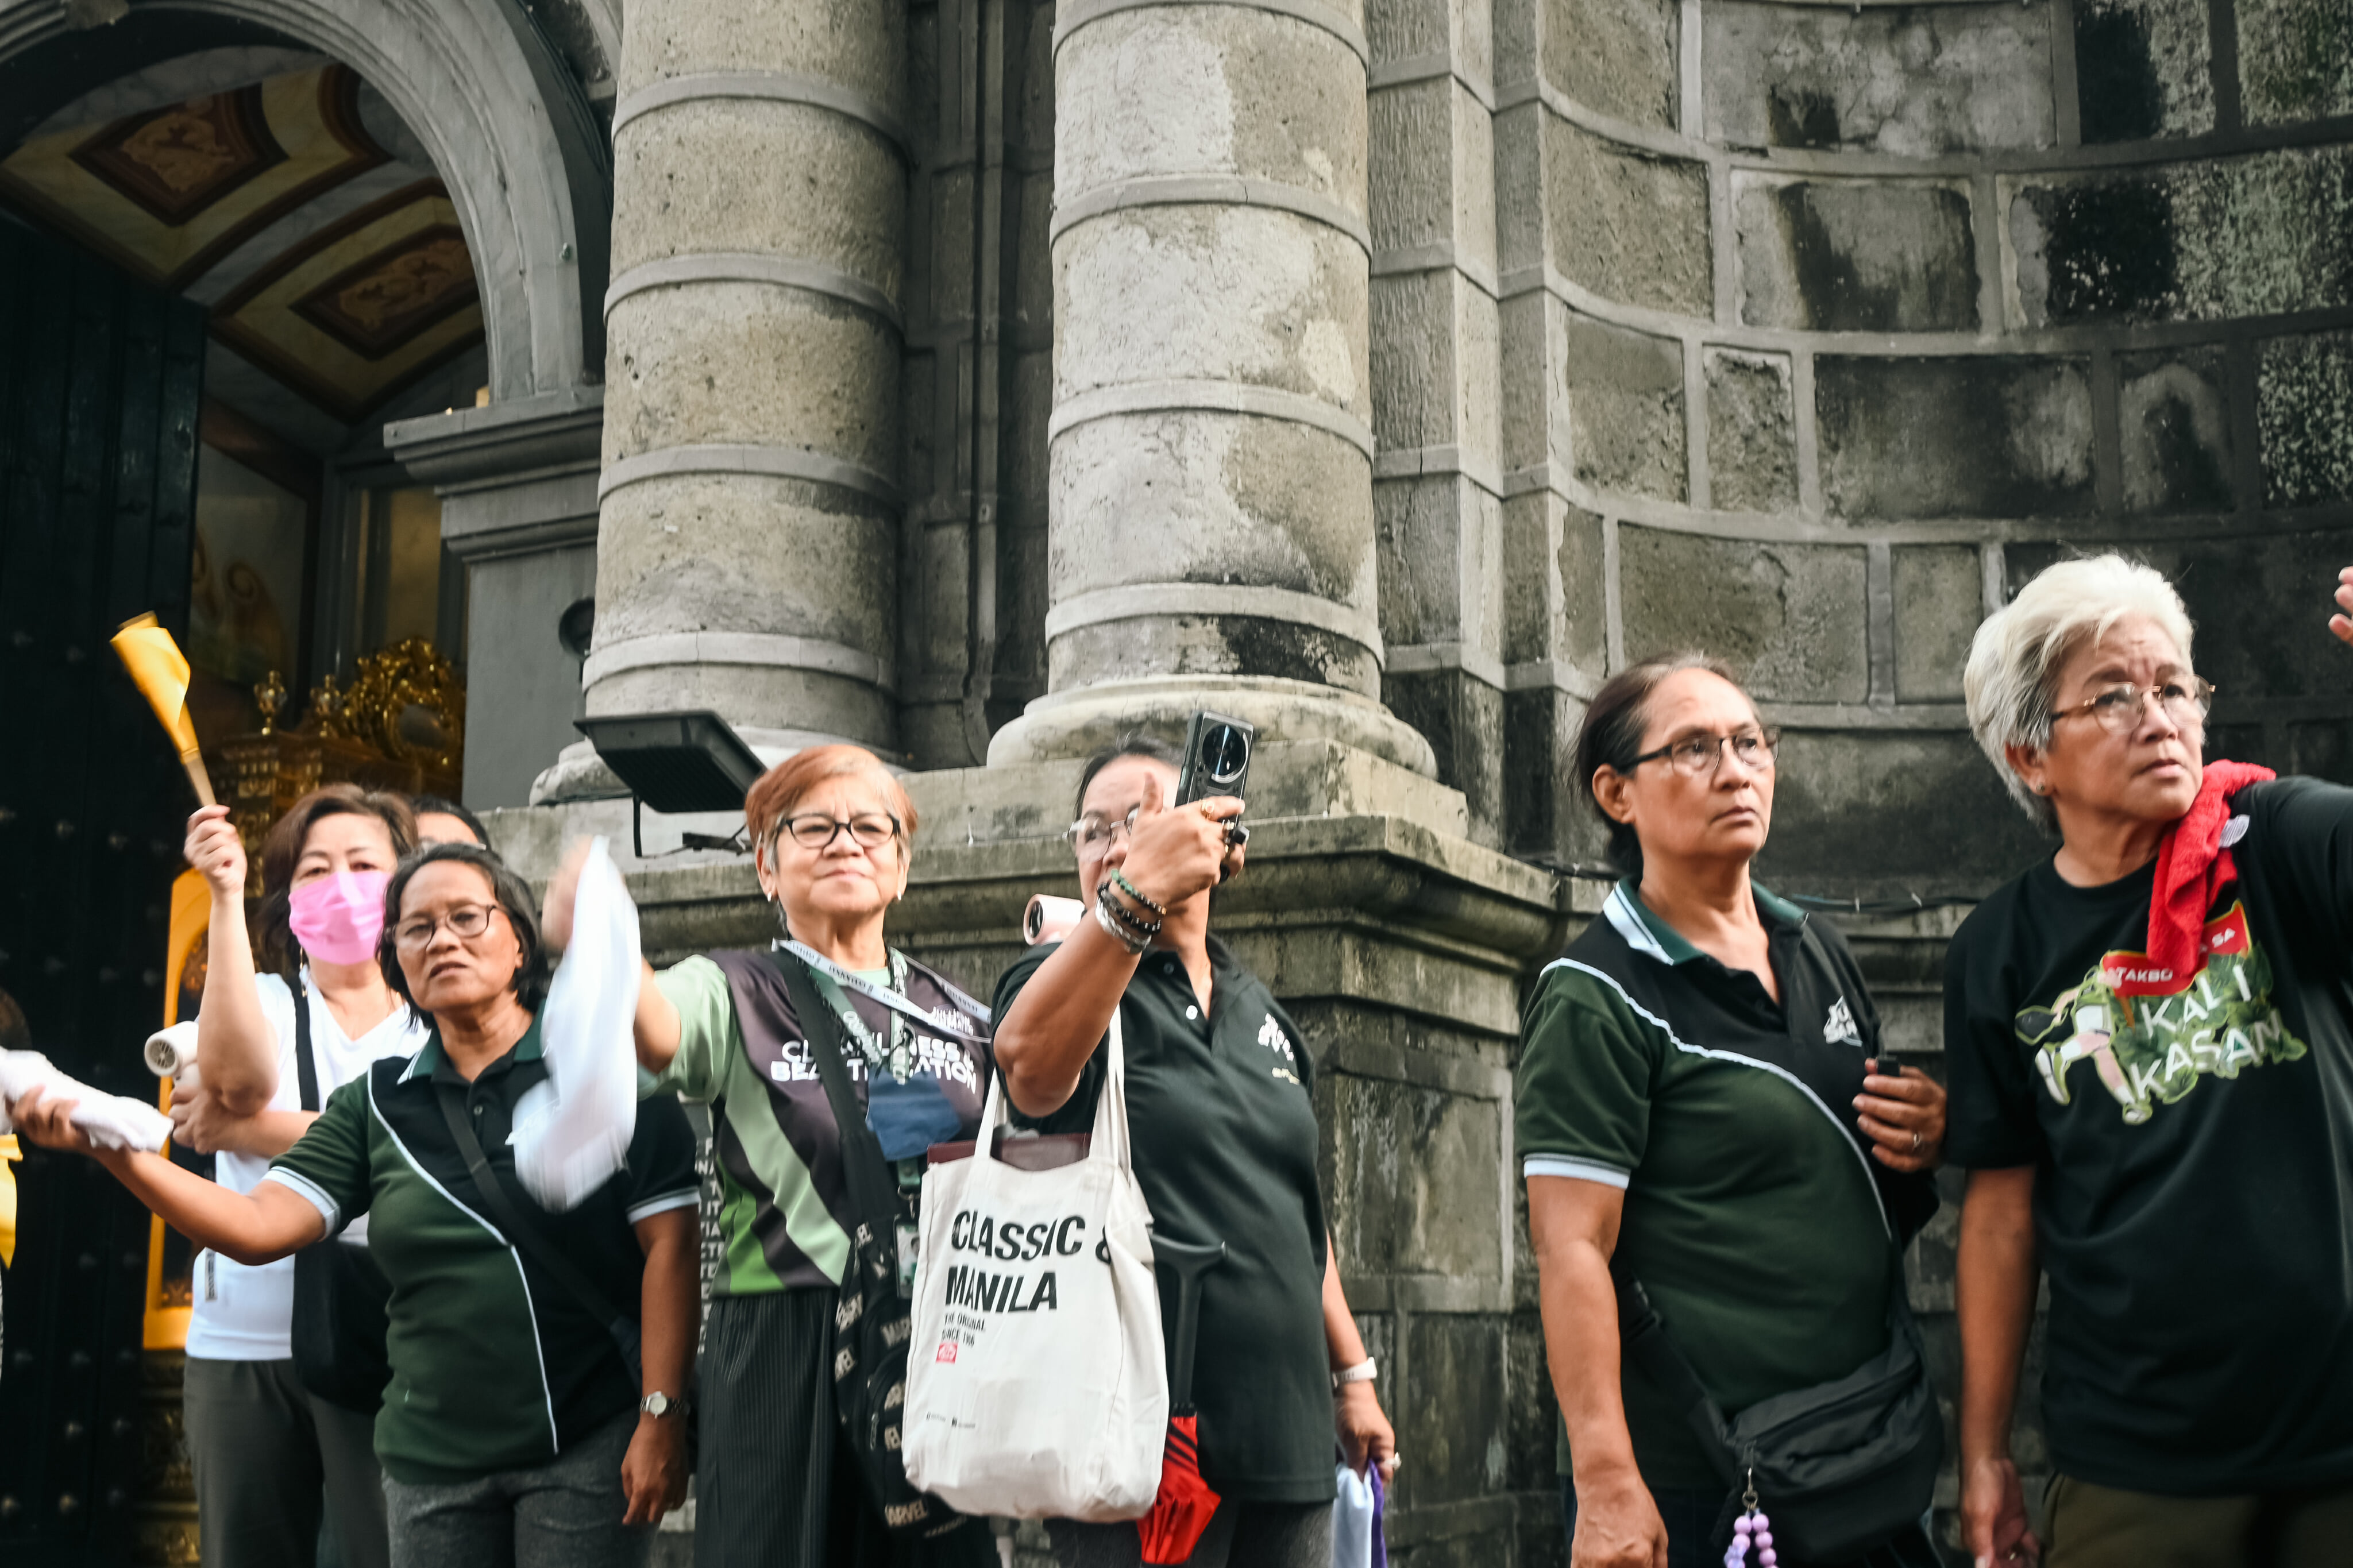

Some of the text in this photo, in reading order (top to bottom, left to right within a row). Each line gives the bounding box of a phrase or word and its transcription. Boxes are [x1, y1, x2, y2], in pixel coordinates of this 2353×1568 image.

[2140, 964, 2251, 1040] KALI
[2130, 1008, 2280, 1099] KASAN
[951, 1210, 1086, 1261] CLASSIC
[945, 1264, 1057, 1314] MANILA
